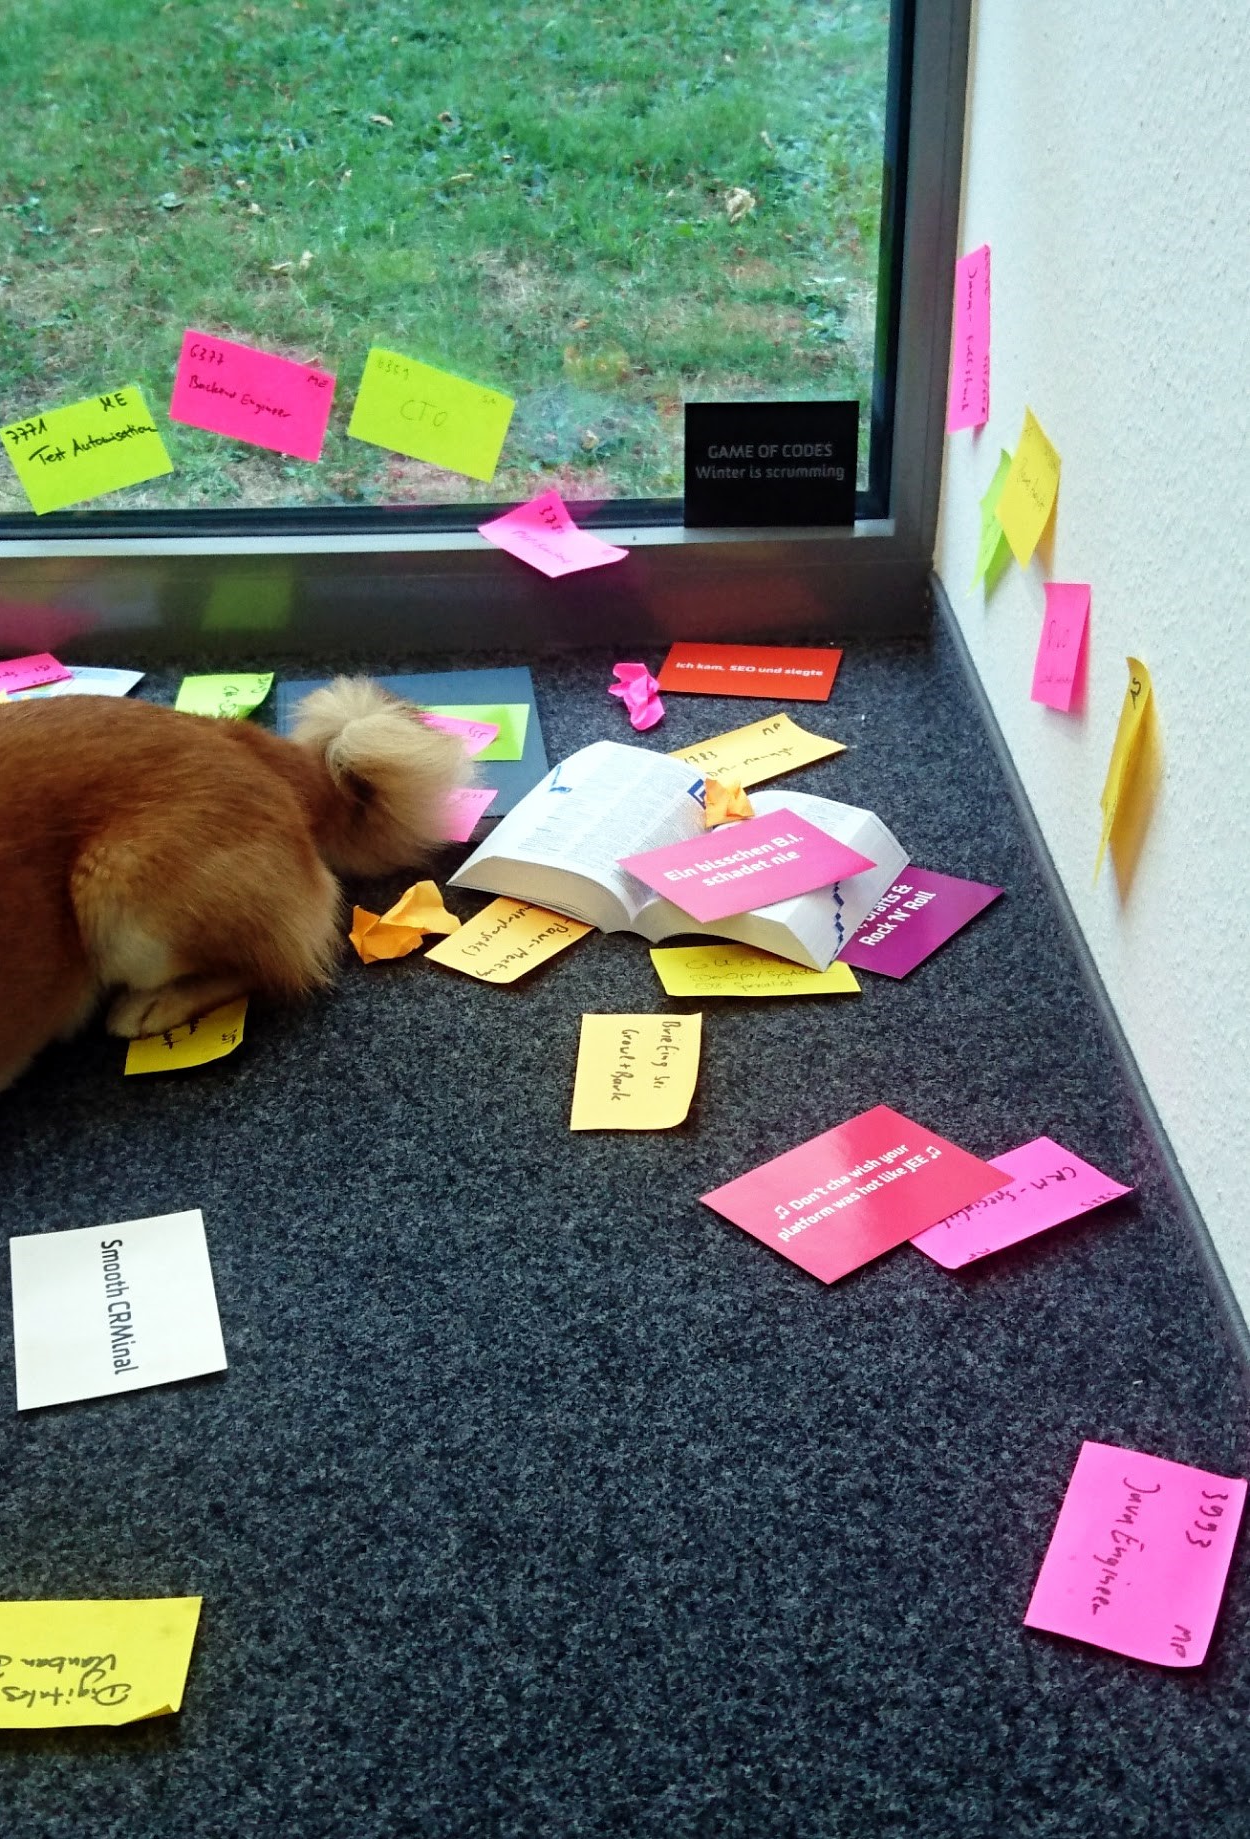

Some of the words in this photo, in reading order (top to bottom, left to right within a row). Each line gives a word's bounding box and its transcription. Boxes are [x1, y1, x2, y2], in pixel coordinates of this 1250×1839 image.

[400, 399, 448, 427] CTO
[695, 464, 746, 479] Winter
[749, 464, 762, 479] is
[765, 464, 845, 482] scrumming
[708, 444, 754, 459] GAME
[757, 444, 779, 459] OF
[782, 442, 833, 458] CODES
[675, 661, 694, 669] Ich
[729, 664, 756, 672] SEO
[758, 666, 782, 674] und
[784, 667, 824, 677] siegte
[663, 867, 699, 881] Ein
[694, 842, 775, 873] bisschen
[702, 858, 772, 887] schadet
[770, 850, 801, 865] nie
[891, 884, 914, 894] &
[858, 922, 898, 946] Rock
[902, 890, 937, 910] Roll
[651, 1021, 682, 1067] Briefing
[777, 1206, 836, 1243] platform
[833, 1192, 862, 1210] was
[855, 1179, 884, 1197] hot
[877, 1167, 908, 1184] like
[902, 1154, 930, 1173] JEE
[788, 1187, 829, 1211] Don't
[826, 1175, 851, 1192] cha
[849, 1159, 881, 1179] wish
[878, 1144, 909, 1164] your
[100, 1239, 129, 1299] Smooth
[107, 1301, 139, 1376] CRMinal
[1115, 1477, 1161, 1525] Java
[1185, 1490, 1229, 1548] 3993
[1091, 1529, 1145, 1615] Engineer
